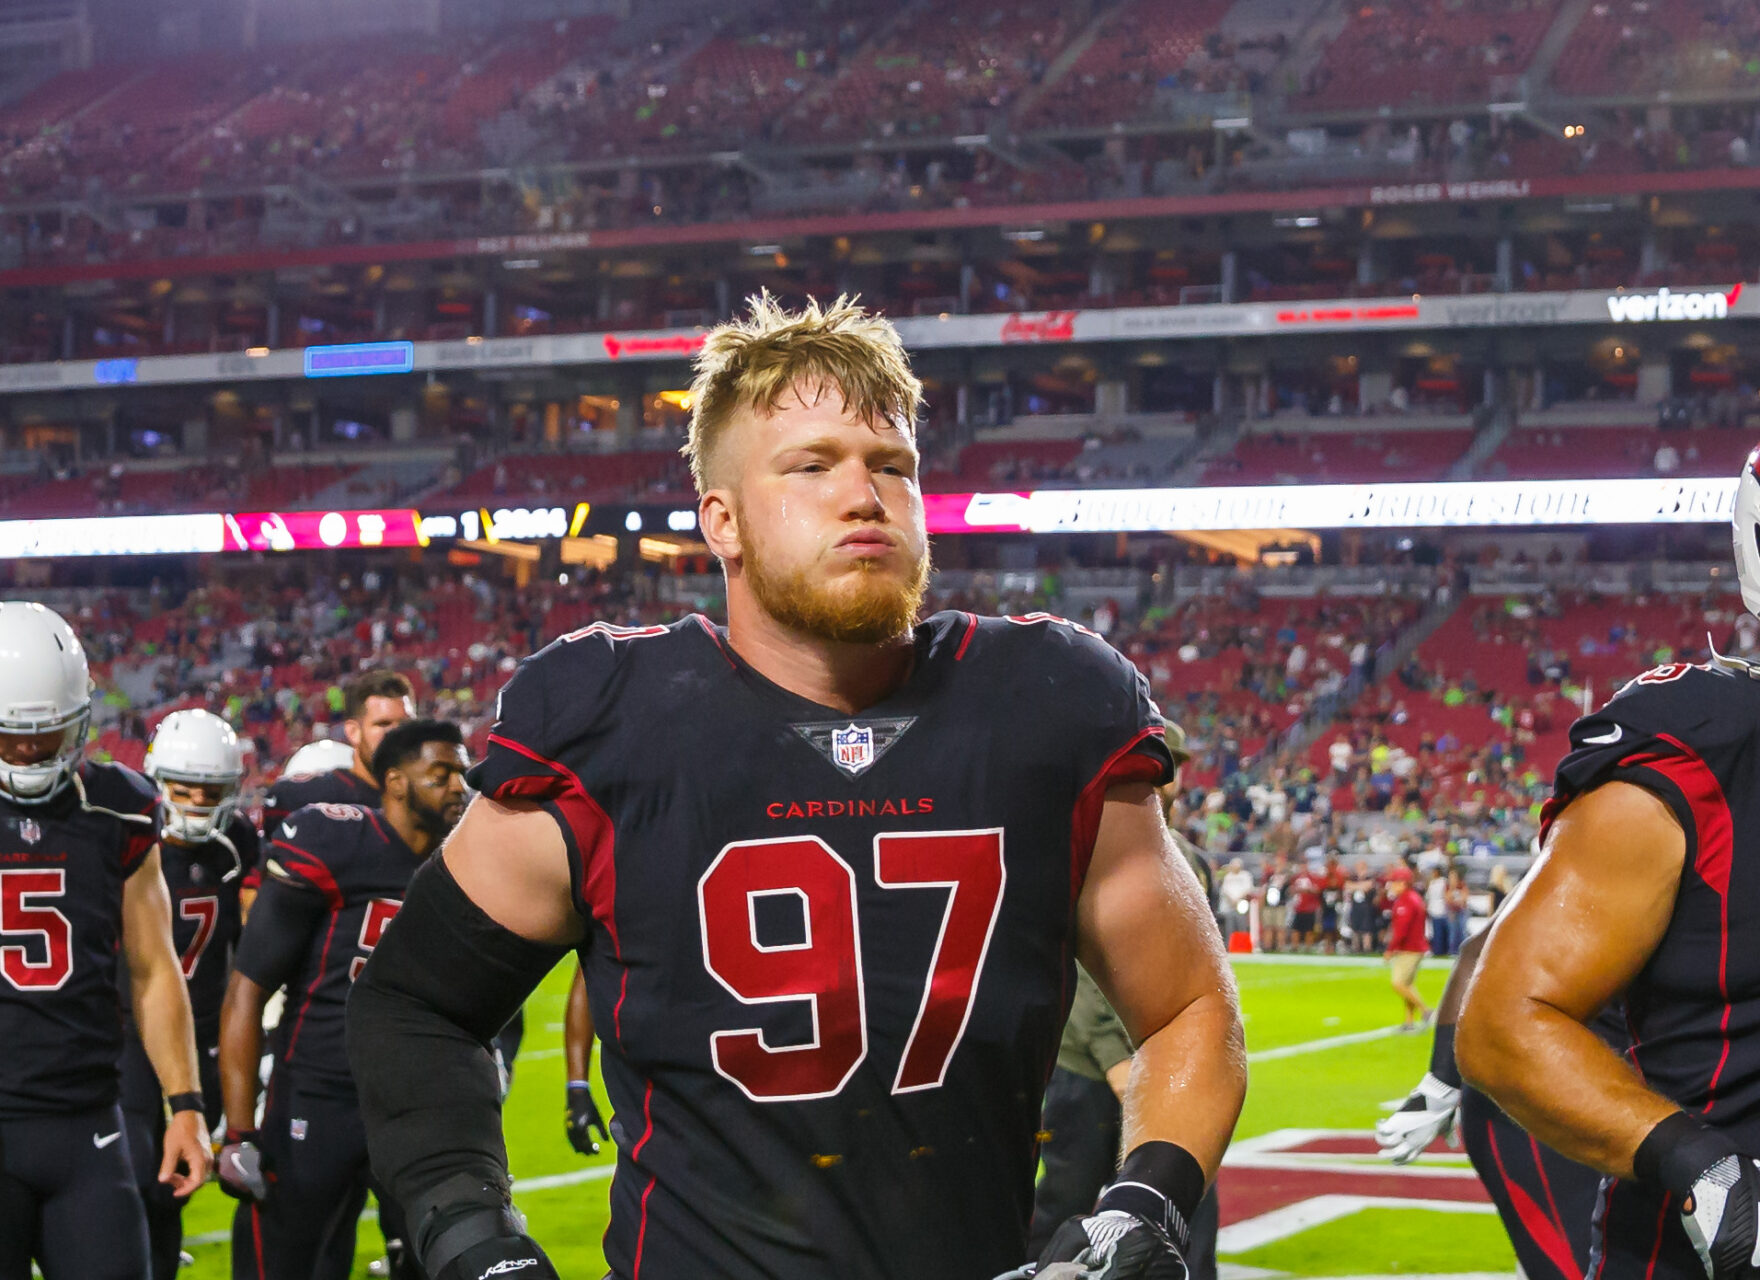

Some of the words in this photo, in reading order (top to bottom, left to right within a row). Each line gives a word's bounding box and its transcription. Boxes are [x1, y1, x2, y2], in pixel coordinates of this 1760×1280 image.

[1606, 287, 1728, 322] verizon
[840, 745, 865, 763] NFL
[766, 797, 934, 819] CARDINALS
[0, 868, 73, 991] 5
[180, 895, 219, 980] 7
[697, 827, 1006, 1102] 97
